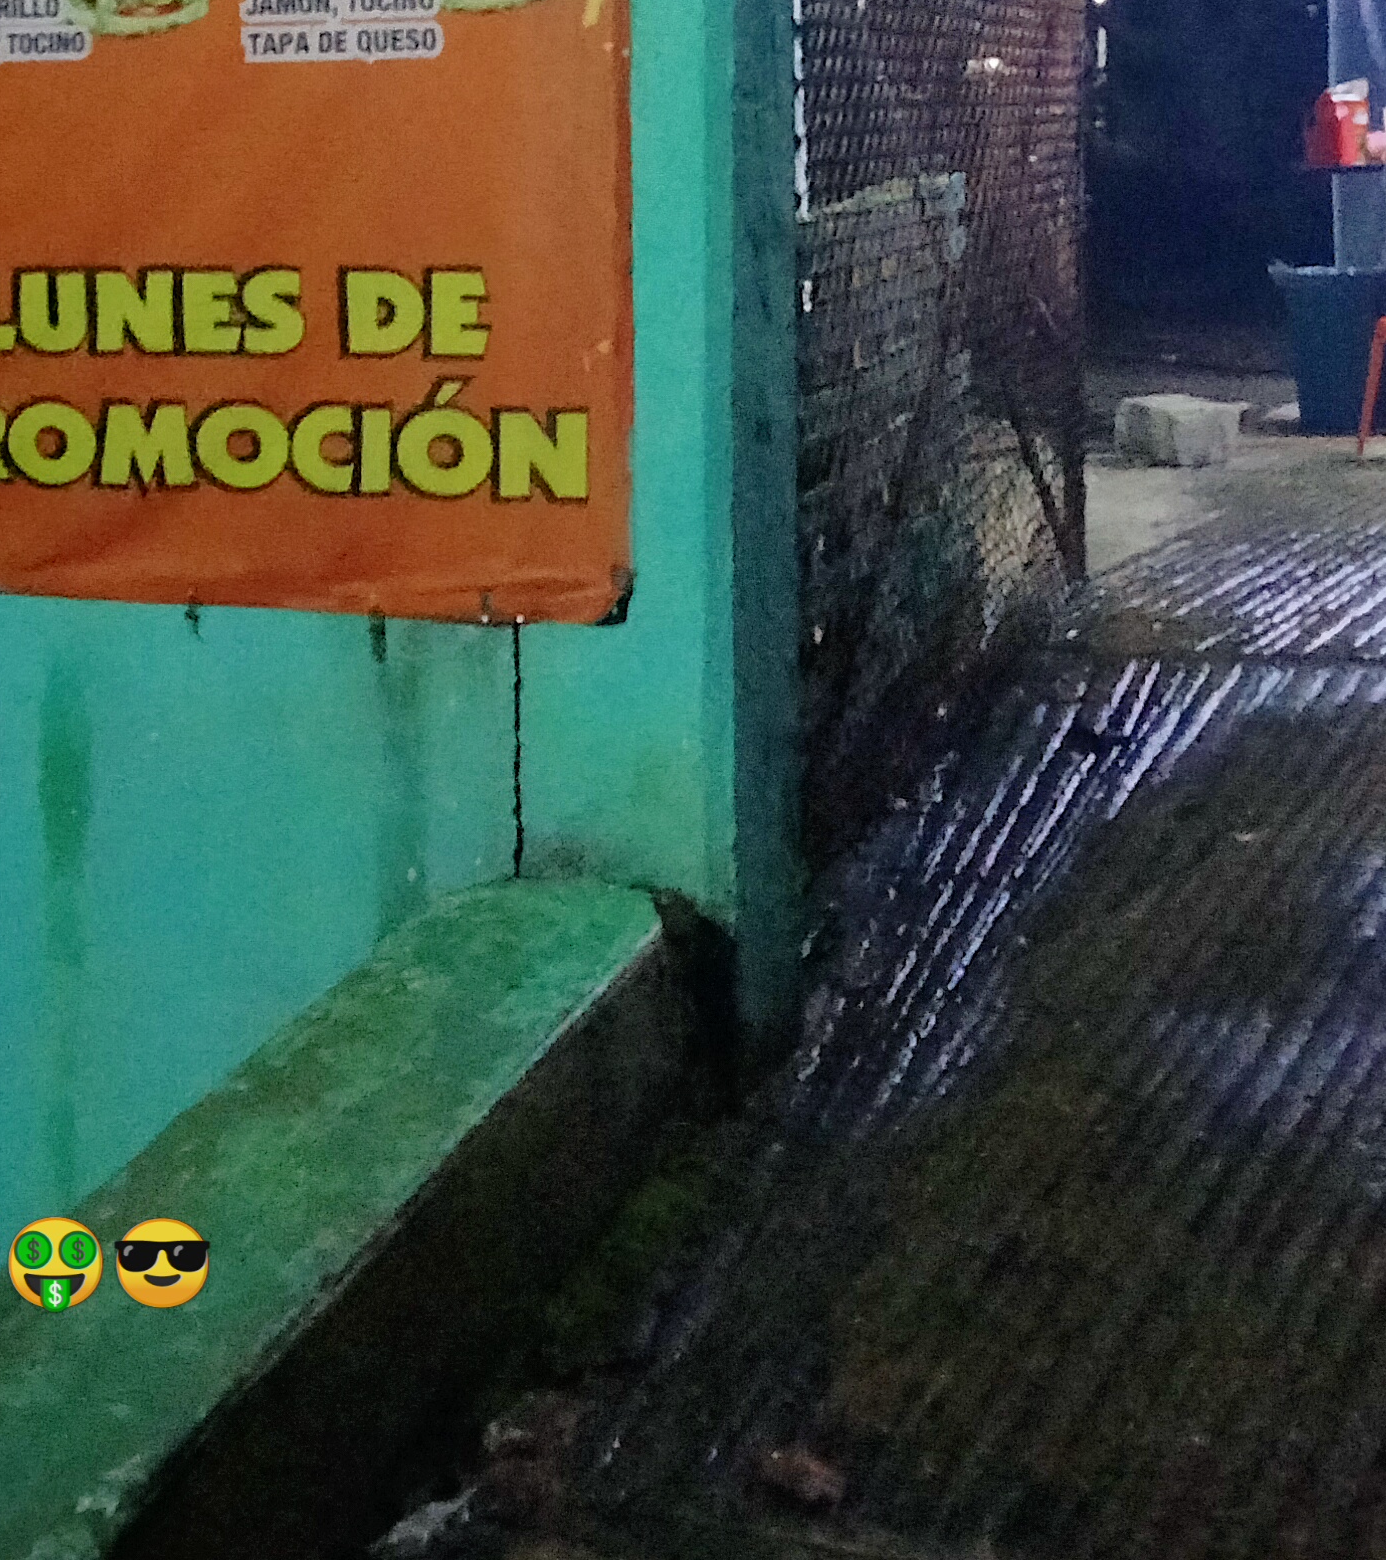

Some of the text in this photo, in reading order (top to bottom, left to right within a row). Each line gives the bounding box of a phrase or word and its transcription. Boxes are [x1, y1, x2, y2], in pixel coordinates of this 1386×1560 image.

[6, 29, 87, 56] TOCINO
[247, 27, 439, 56] TAPA DE QUESO
[338, 265, 493, 359] DE
